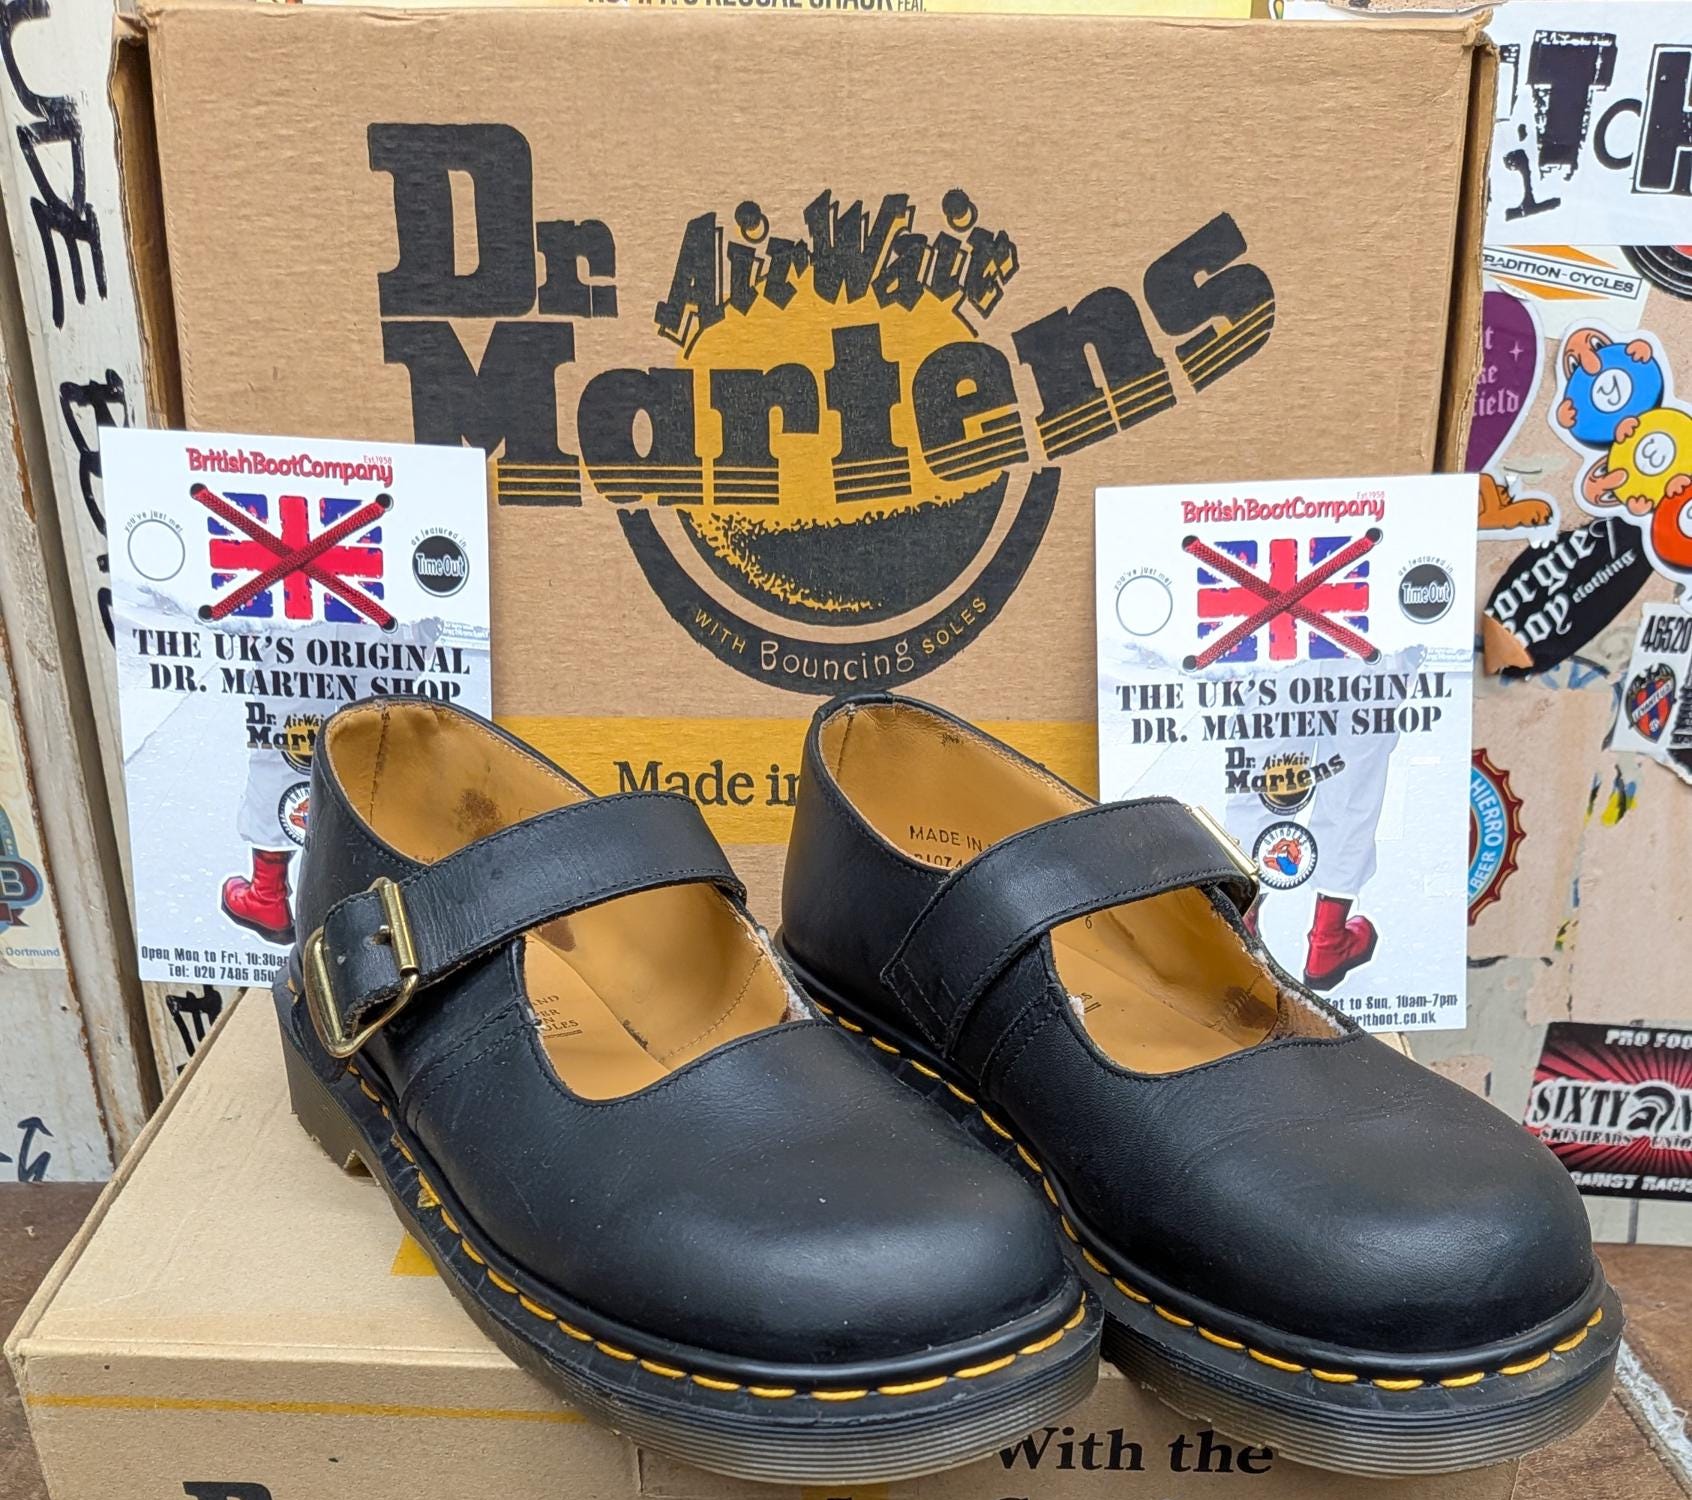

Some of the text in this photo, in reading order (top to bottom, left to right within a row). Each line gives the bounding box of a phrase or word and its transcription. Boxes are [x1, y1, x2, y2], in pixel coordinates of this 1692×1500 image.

[367, 122, 618, 318] Dr
[655, 187, 1020, 345] AirWair
[381, 211, 1276, 506] Martens
[186, 447, 393, 488] BritishBootCompany
[1181, 496, 1386, 524] BritishBootCompany
[1484, 529, 1597, 618] orgie
[1572, 549, 1637, 604] clothing
[132, 628, 471, 675] THE UK'S ORIGINAL
[694, 596, 988, 681] WITH Bouncing SOLES
[150, 663, 462, 702] DR. MARTEN SHOP
[1116, 671, 1453, 712] THE UK'S ORIGINAL
[246, 725, 317, 750] Mart
[1131, 706, 1443, 744] DR. MARTEN SHOP
[613, 760, 756, 807] Made
[1225, 753, 1346, 794] Martens
[909, 825, 983, 852] MADE IN
[6, 946, 61, 958] Dortmund
[141, 945, 170, 962] Open
[174, 947, 200, 962] Mon
[204, 950, 217, 963] to
[168, 963, 277, 982] Tel: 020 7485 850
[1350, 998, 1362, 1011] to
[1604, 1028, 1650, 1046] PRO
[1531, 1084, 1631, 1129] SIXTY
[1540, 1127, 1633, 1147] SKINHEADS
[1569, 1170, 1640, 1190] GAINST
[1000, 1425, 1273, 1474] With the
